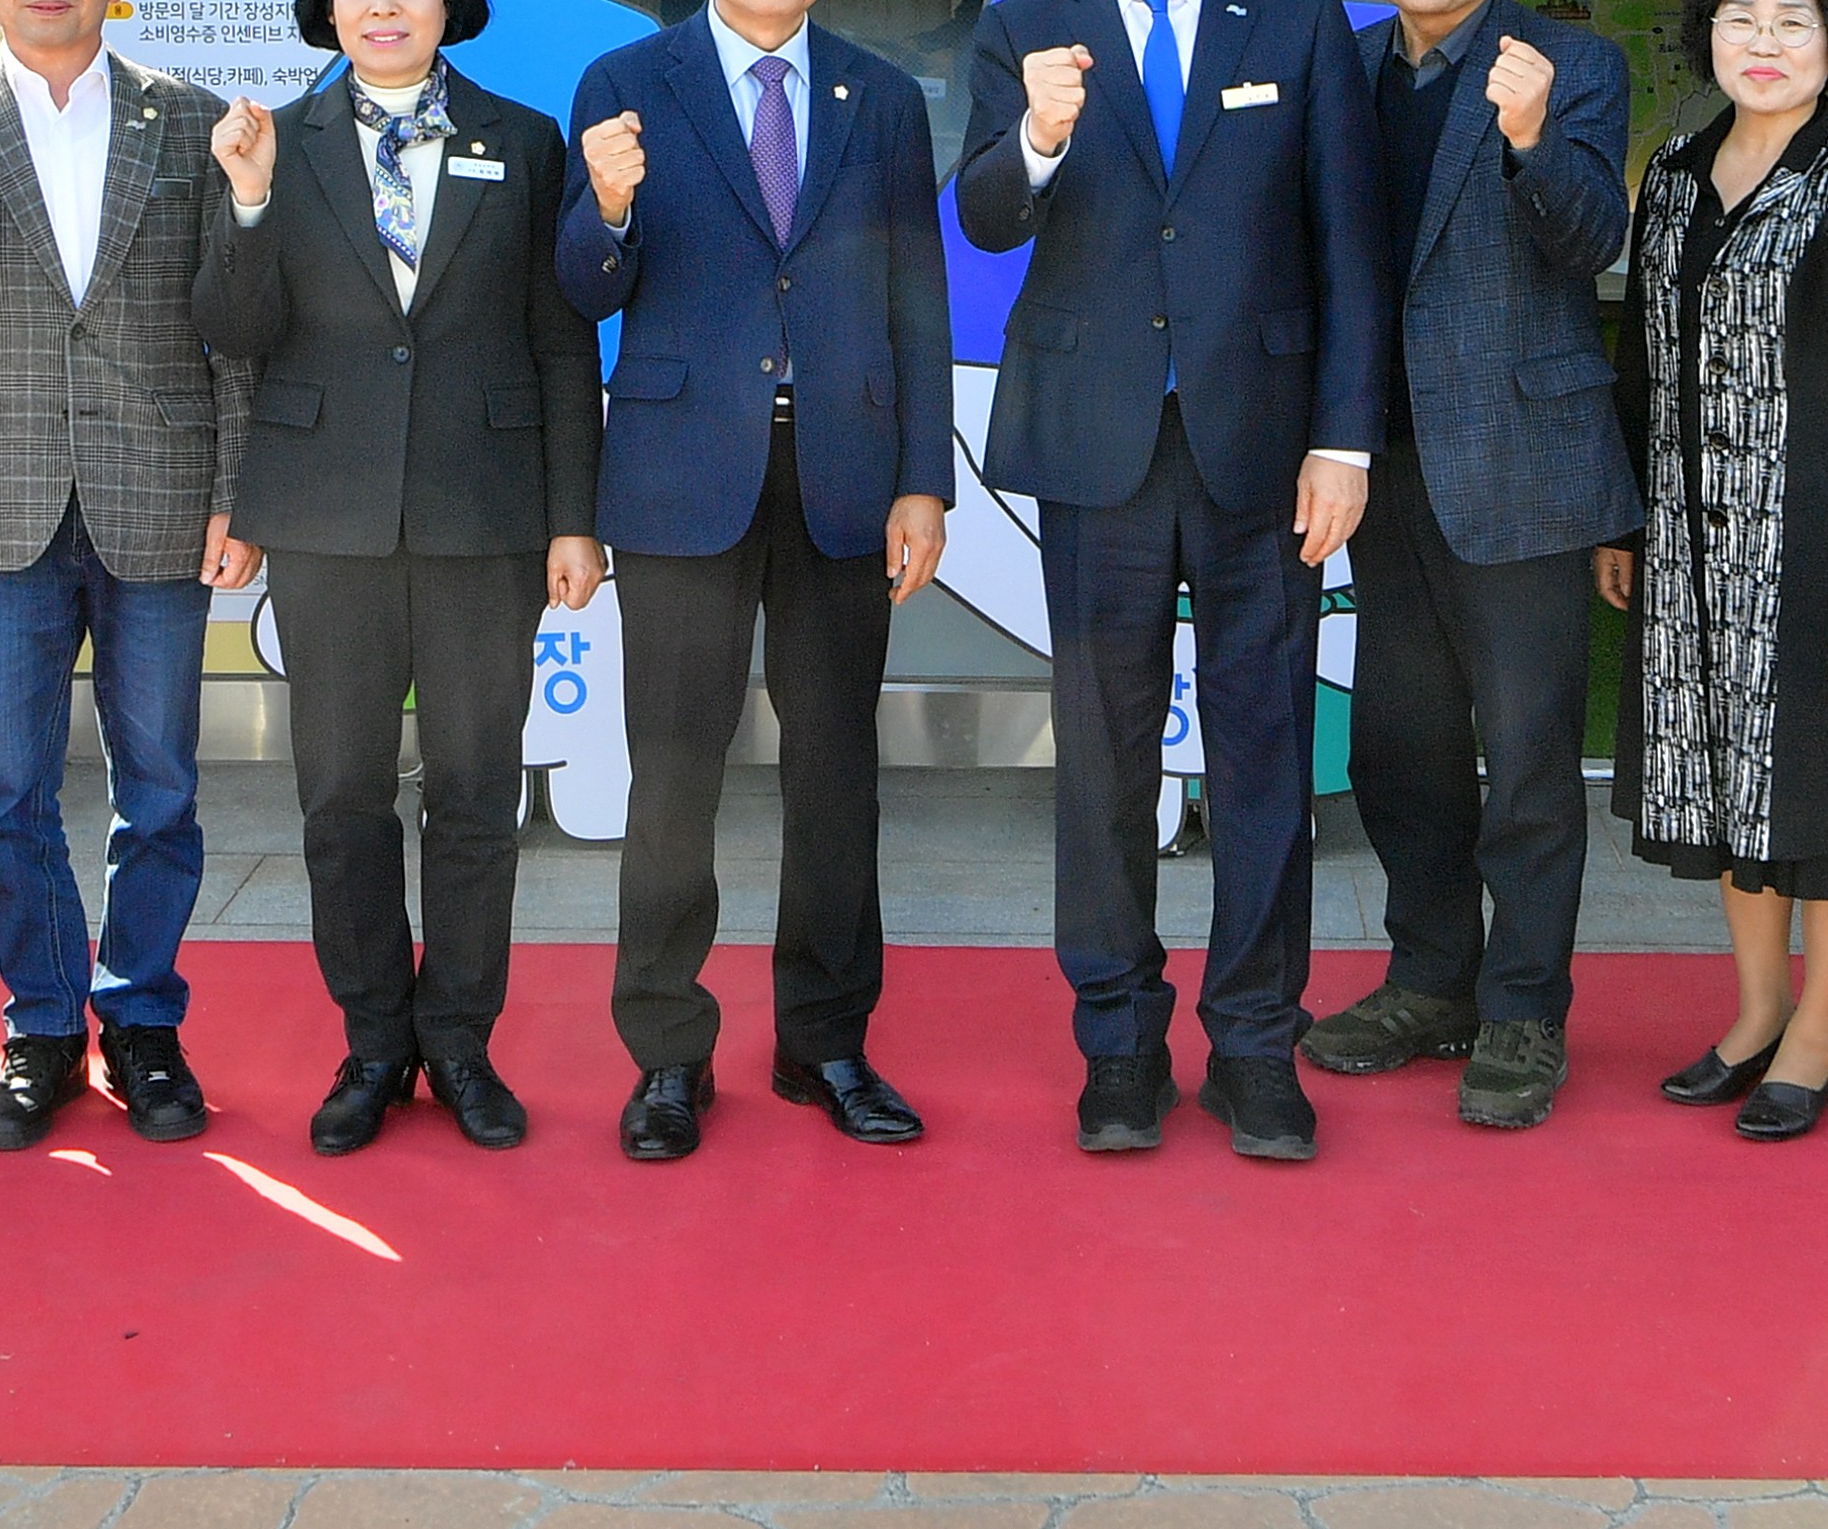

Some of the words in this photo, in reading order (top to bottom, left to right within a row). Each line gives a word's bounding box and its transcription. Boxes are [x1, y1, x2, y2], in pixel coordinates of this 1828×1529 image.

[139, 2, 185, 20] 방문의
[190, 2, 205, 20] 달
[210, 2, 240, 20] 기간
[139, 25, 217, 44] 소비영수증
[221, 25, 283, 44] 인센티브
[287, 25, 302, 44] 지
